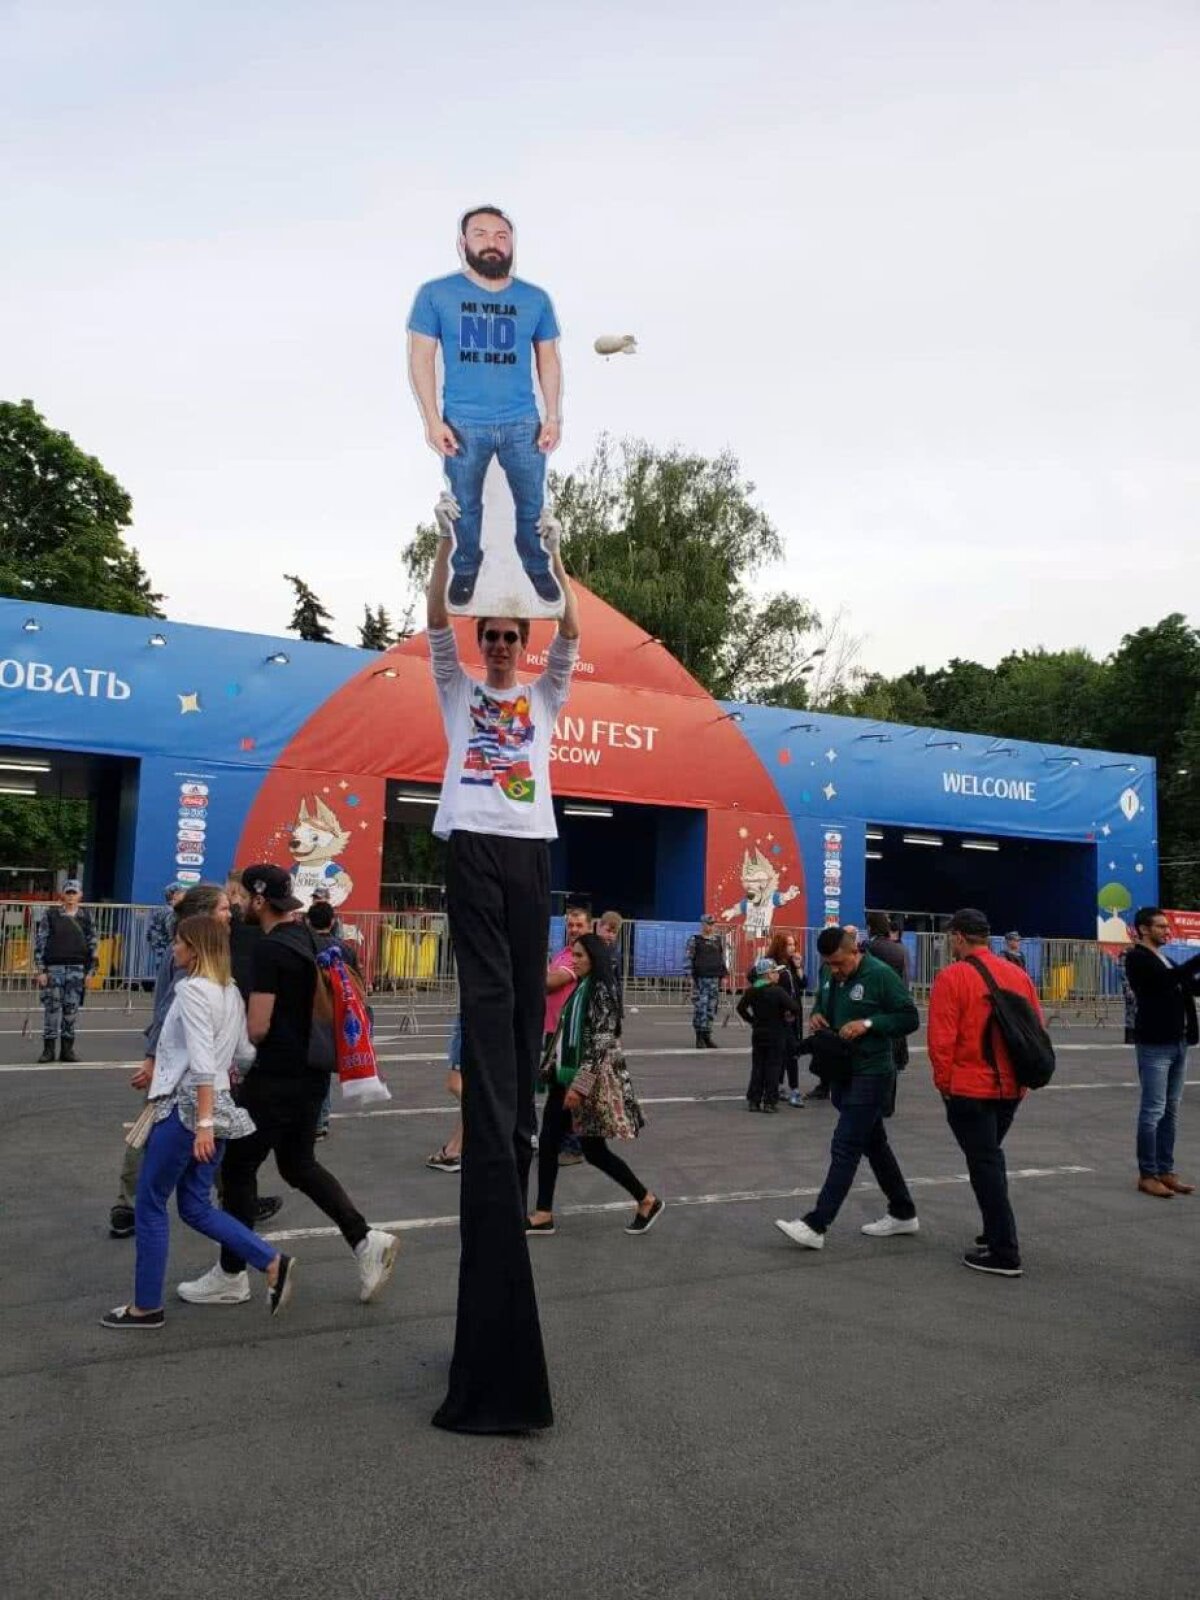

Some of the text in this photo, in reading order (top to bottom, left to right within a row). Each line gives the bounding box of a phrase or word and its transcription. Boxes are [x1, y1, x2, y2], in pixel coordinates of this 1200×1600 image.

[460, 301, 517, 316] MI VIEJA
[460, 315, 517, 351] NO
[460, 351, 480, 363] ME
[591, 719, 660, 752] FEST
[548, 744, 601, 767] SCOW
[943, 772, 1037, 802] WELCOME
